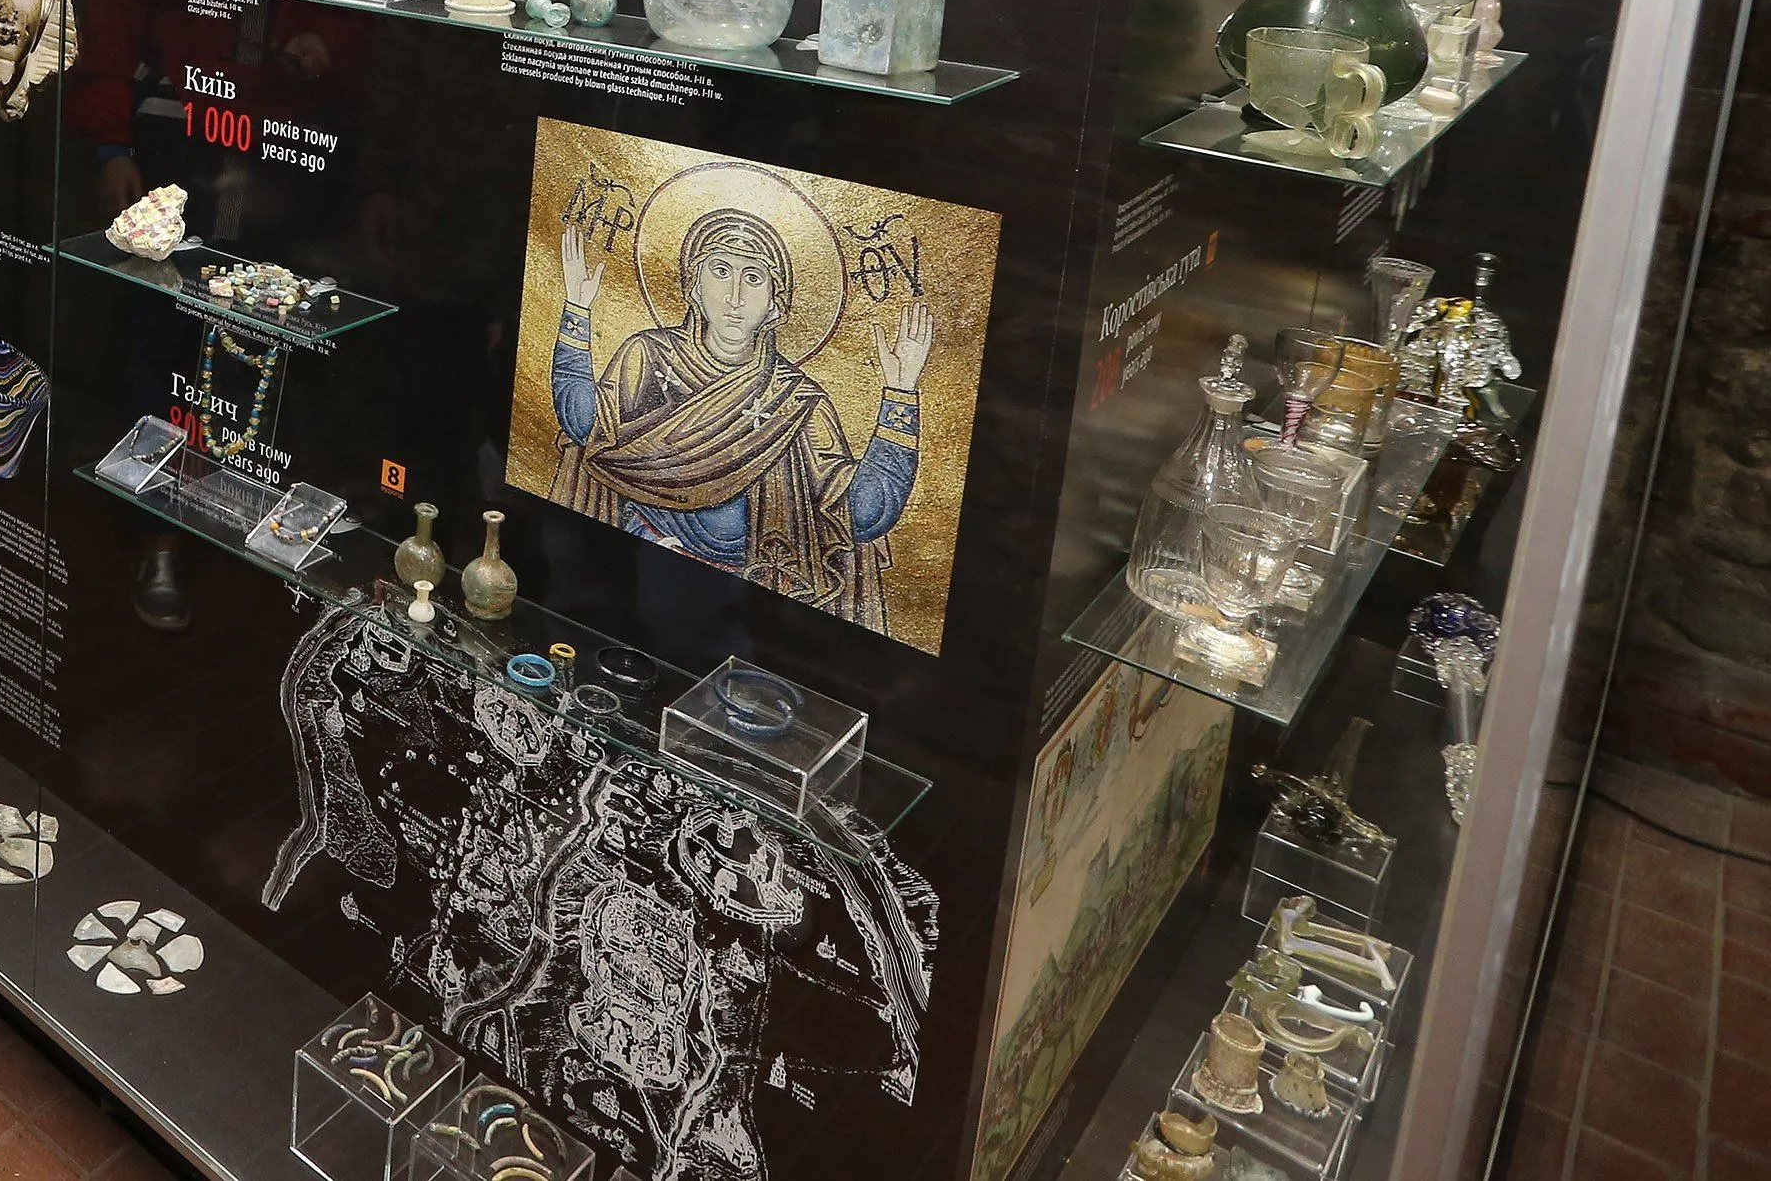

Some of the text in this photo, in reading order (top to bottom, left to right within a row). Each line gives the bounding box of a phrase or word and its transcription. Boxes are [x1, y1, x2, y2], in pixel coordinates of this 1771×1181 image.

[502, 52, 527, 64] Szklane
[528, 57, 556, 69] naczynia
[557, 62, 591, 76] wykonane
[600, 70, 629, 83] technice
[503, 41, 542, 55] Стеклянная
[544, 49, 566, 61] посуда
[568, 54, 621, 70] изготовленная
[184, 65, 237, 101] Київ
[501, 63, 517, 74] Glass
[518, 66, 541, 78] vessels
[543, 71, 574, 84] produced
[575, 76, 584, 87] by
[585, 78, 606, 90] blown
[607, 83, 625, 94] glass
[626, 86, 665, 101] technique.
[184, 102, 252, 152] 1 000
[263, 117, 338, 154] років тому
[261, 141, 325, 172] years ago
[259, 443, 291, 469] тому
[256, 464, 280, 484] ago
[388, 466, 400, 486] 8
